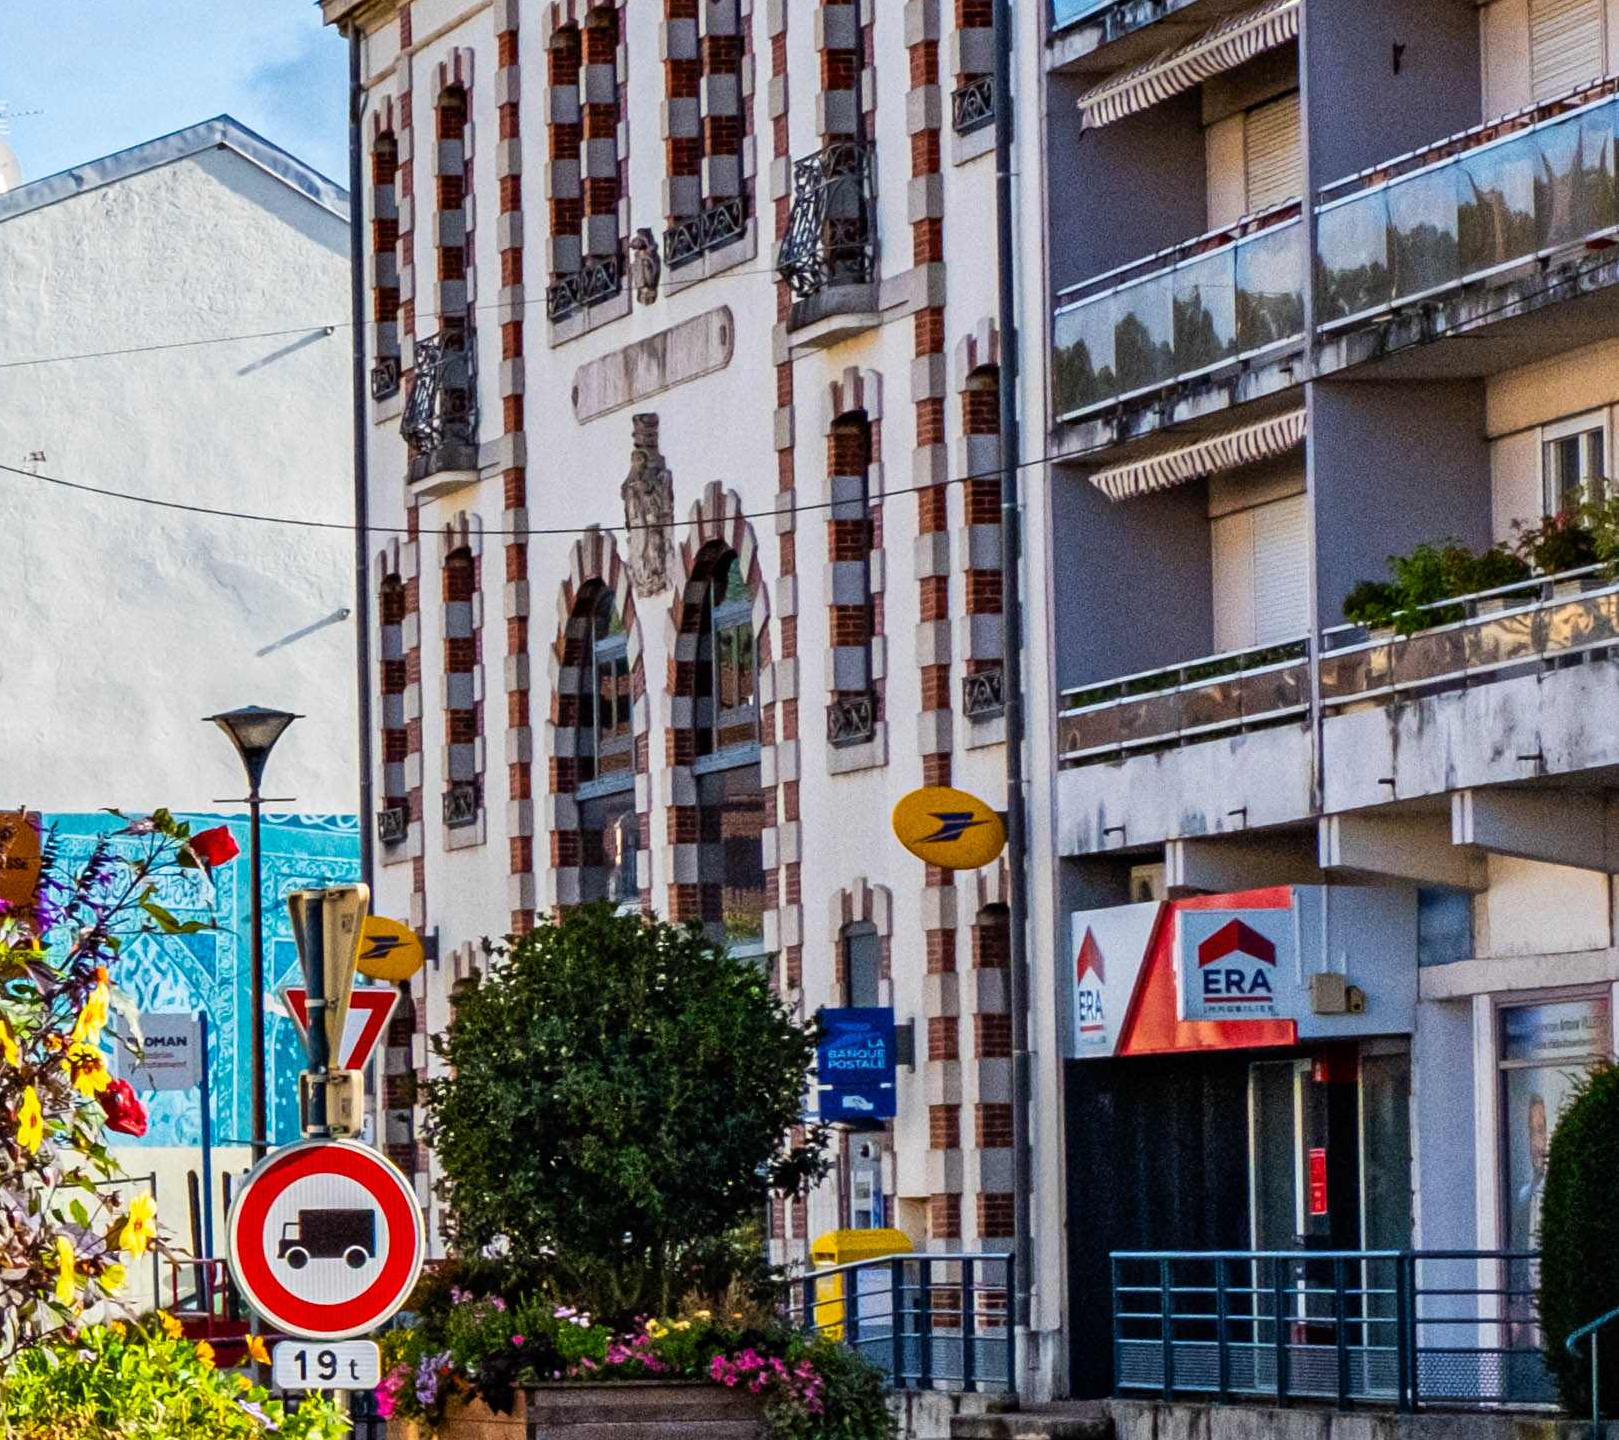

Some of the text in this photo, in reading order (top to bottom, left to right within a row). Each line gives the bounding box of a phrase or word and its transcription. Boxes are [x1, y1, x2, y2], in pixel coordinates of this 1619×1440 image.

[1203, 968, 1273, 994] ERA
[1079, 989, 1105, 1022] ERA
[867, 1038, 885, 1048] LA
[827, 1049, 886, 1059] BANQUE
[827, 1059, 886, 1070] POSTALE
[294, 1349, 361, 1381] 19 t
